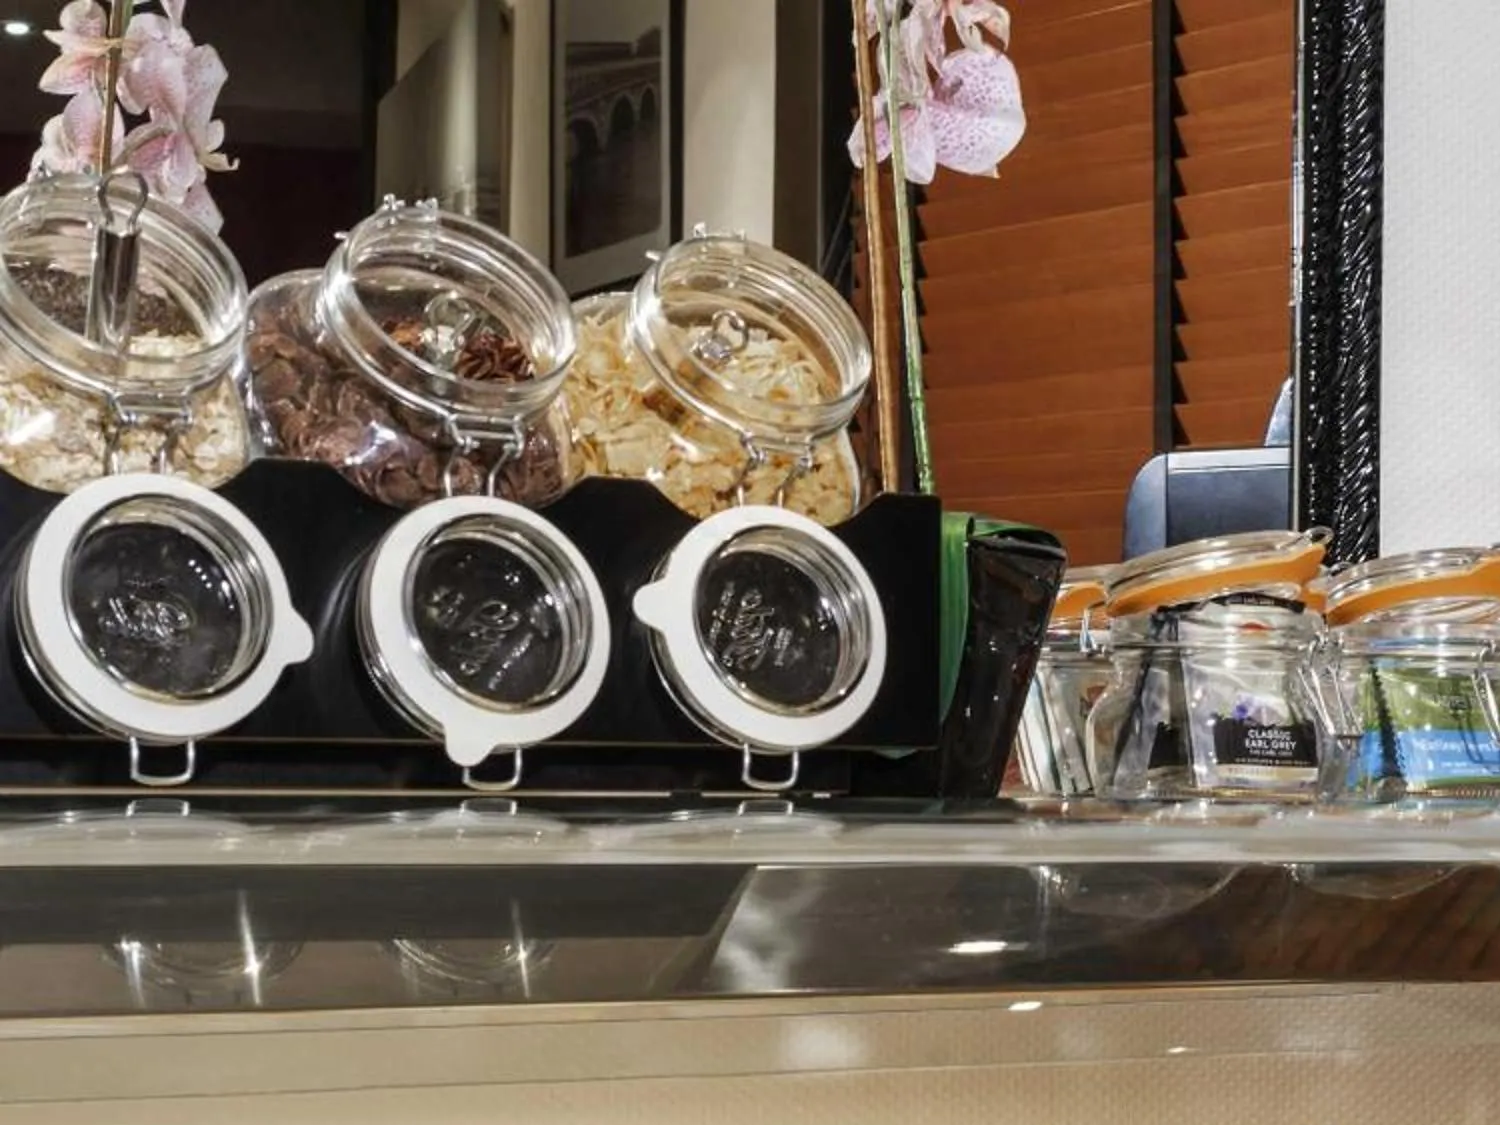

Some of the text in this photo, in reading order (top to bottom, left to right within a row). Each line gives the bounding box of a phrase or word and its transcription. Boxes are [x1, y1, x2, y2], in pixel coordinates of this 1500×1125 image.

[1248, 729, 1292, 740] CLASSIC
[1245, 739, 1297, 750] EARL GREY
